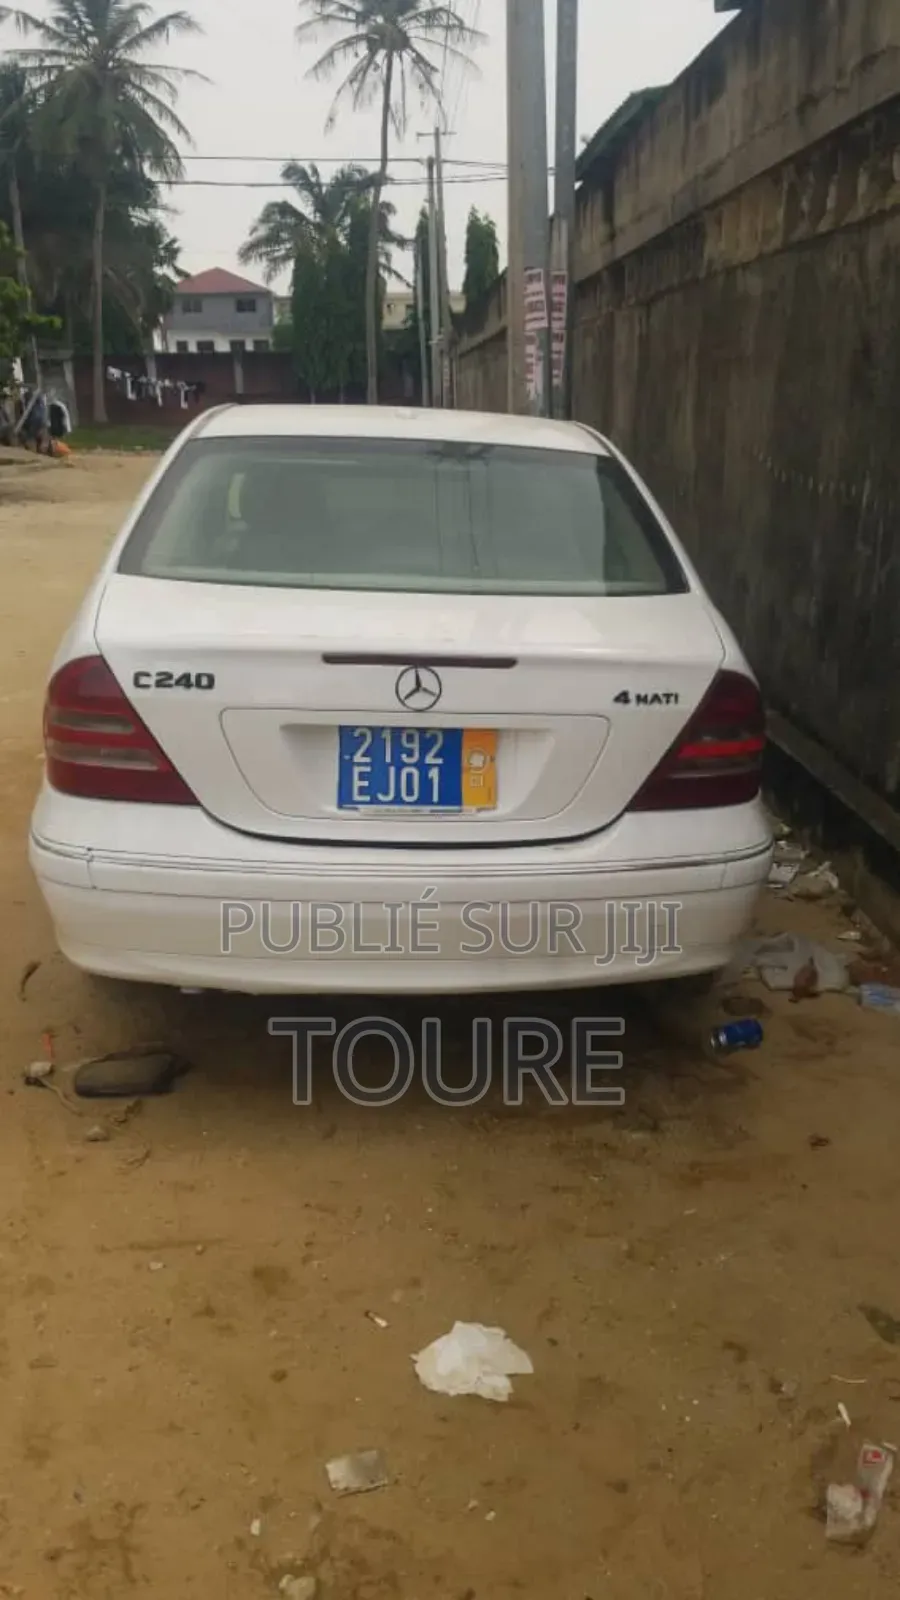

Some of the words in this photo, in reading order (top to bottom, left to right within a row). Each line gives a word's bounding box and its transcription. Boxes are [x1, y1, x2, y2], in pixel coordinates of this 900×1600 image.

[133, 671, 215, 690] C240
[613, 690, 631, 704] 4
[353, 727, 444, 764] 2192
[352, 765, 440, 803] EJ01
